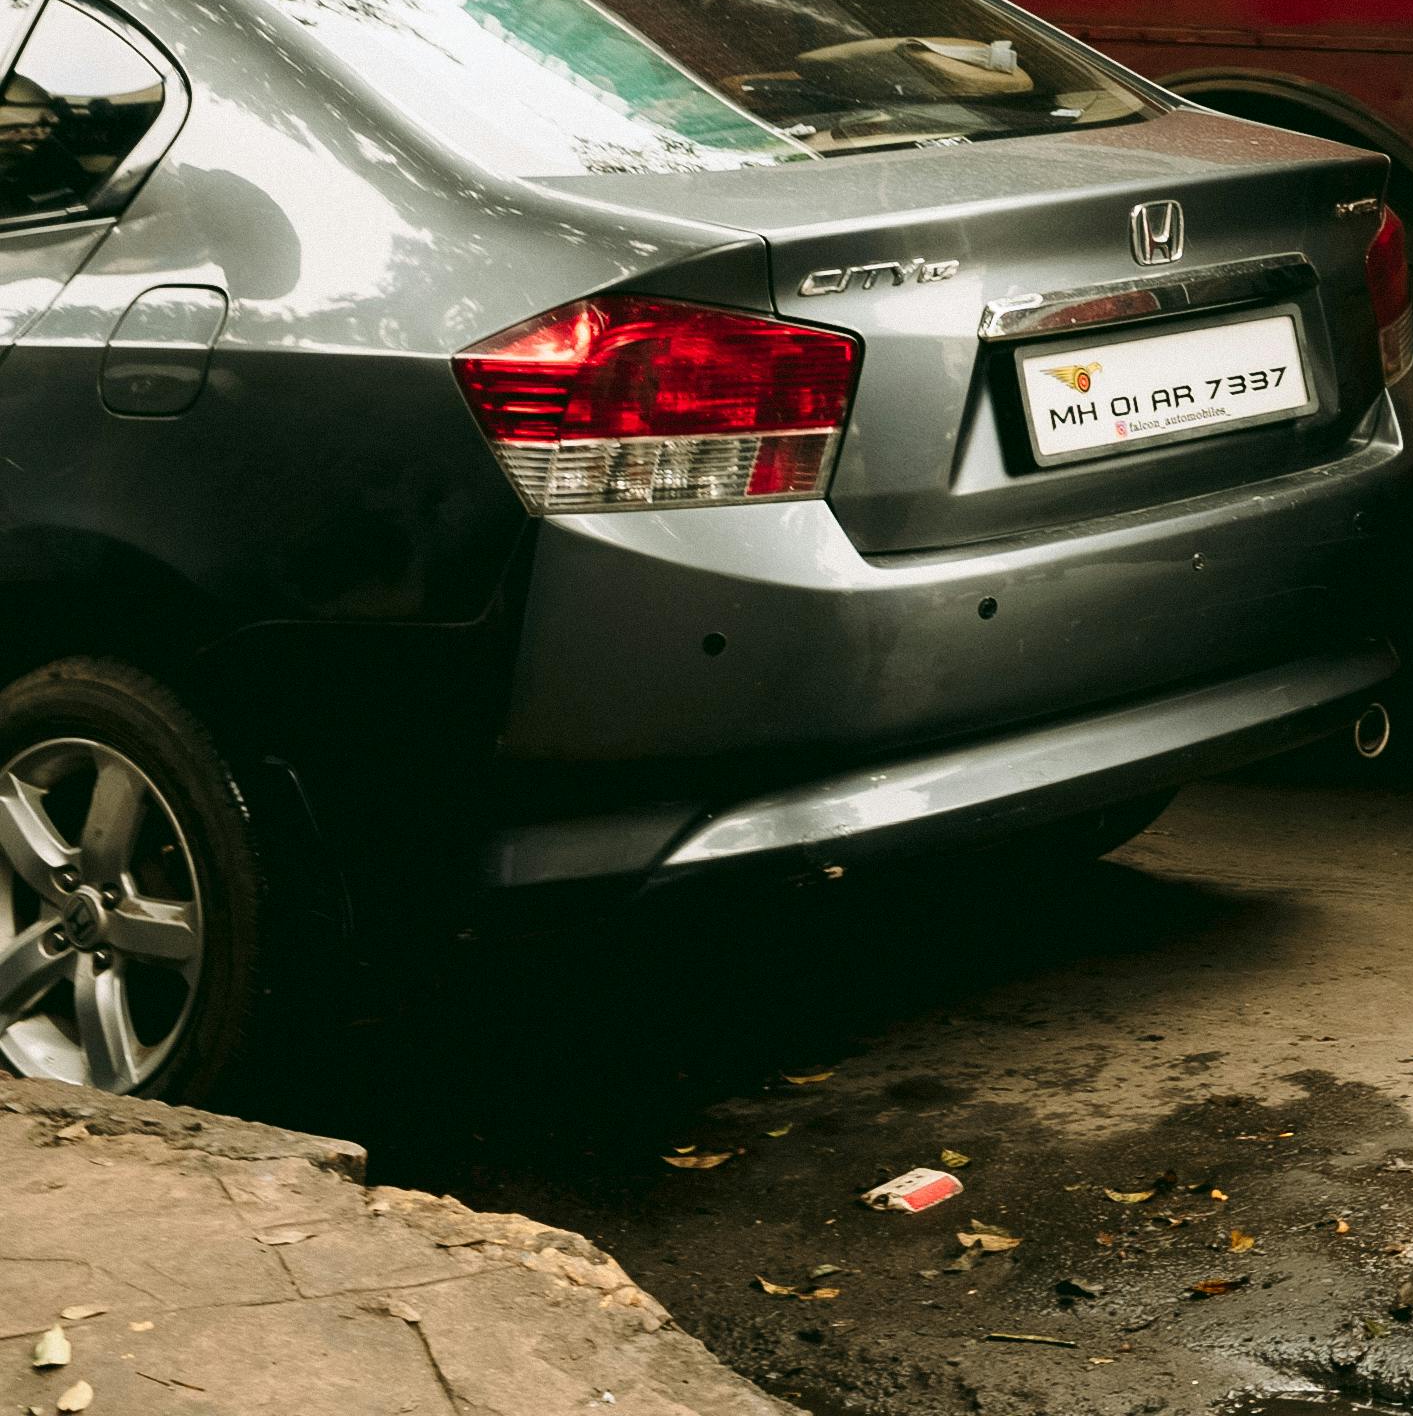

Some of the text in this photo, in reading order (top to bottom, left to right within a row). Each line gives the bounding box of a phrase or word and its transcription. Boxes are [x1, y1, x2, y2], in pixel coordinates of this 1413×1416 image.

[1049, 366, 1288, 431] MH 01 AR 7337
